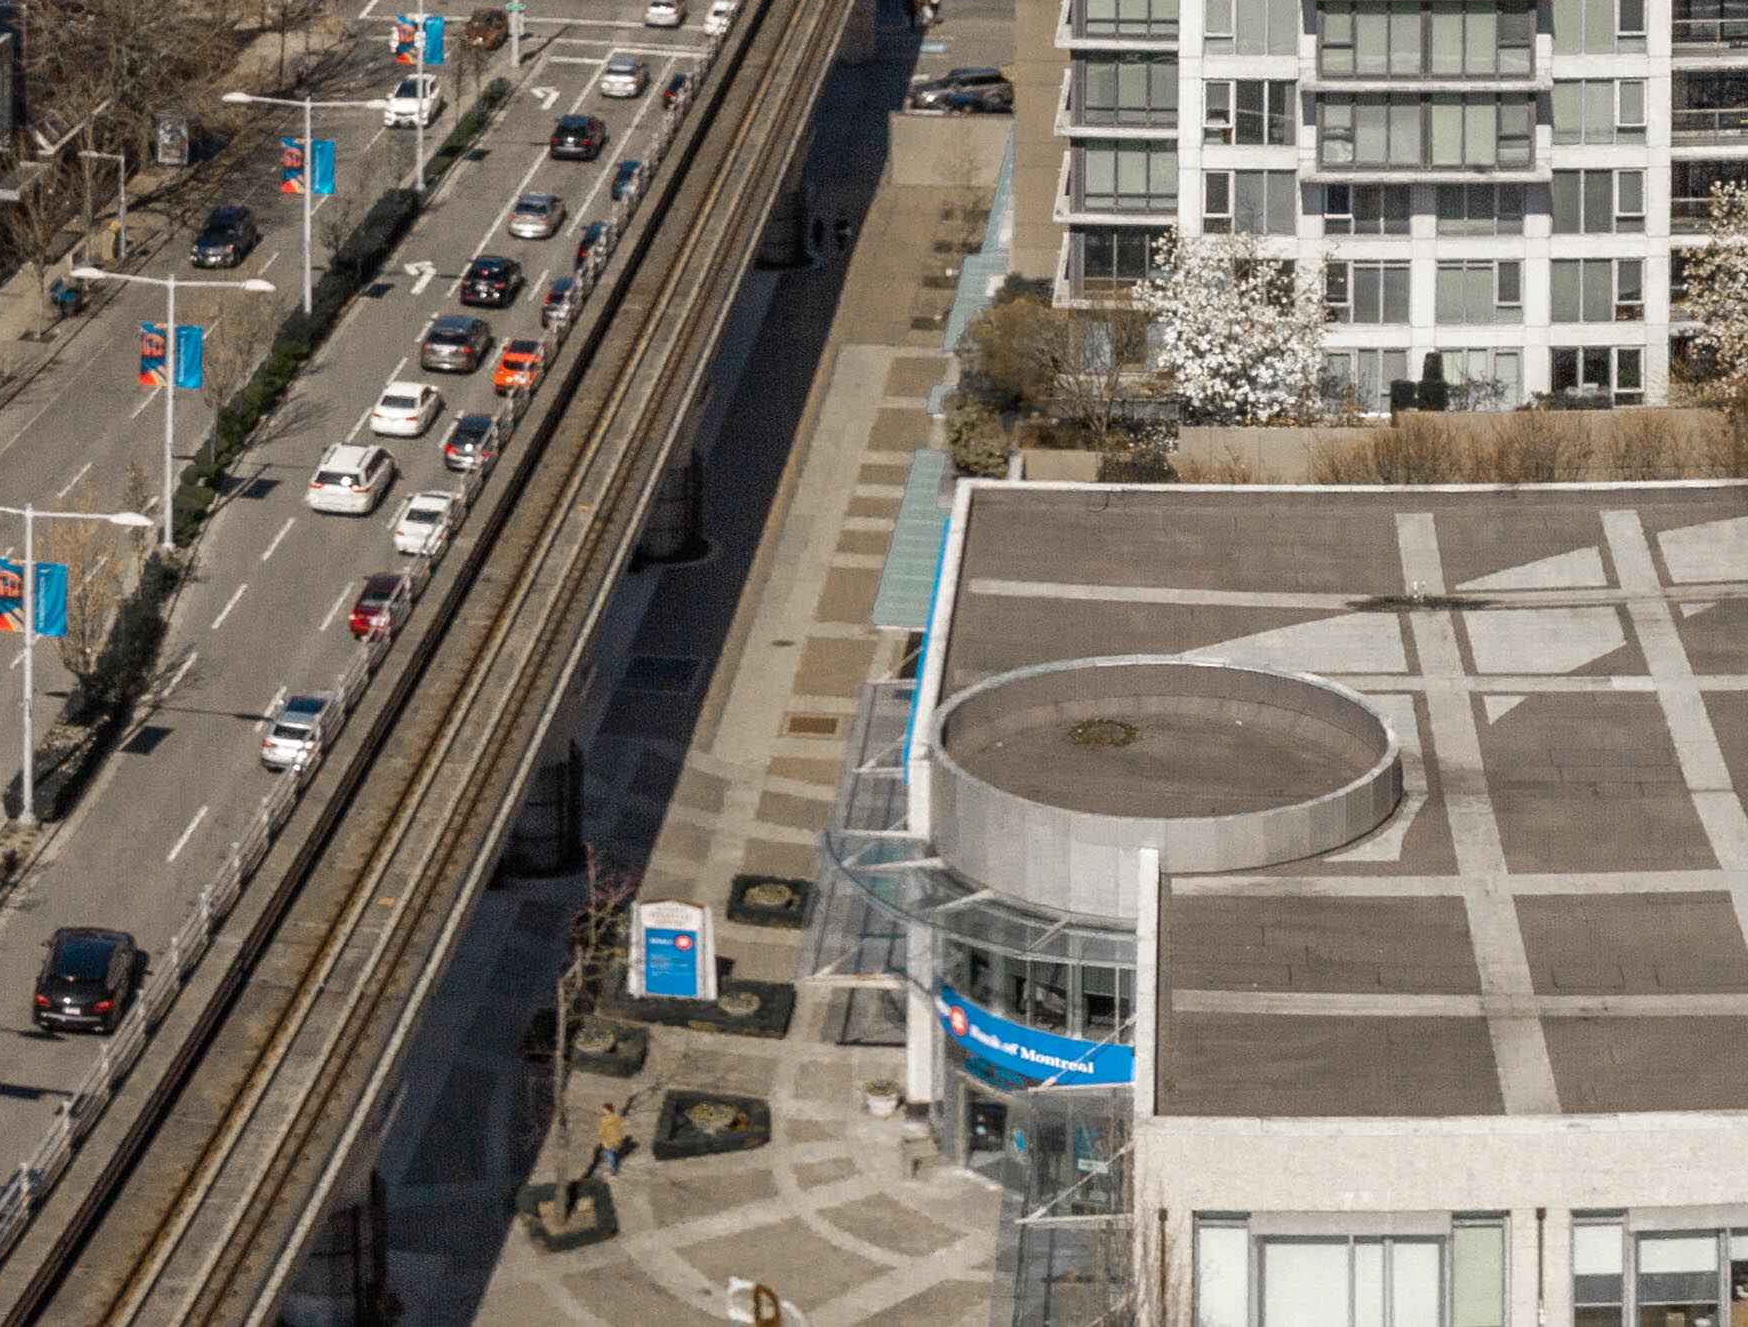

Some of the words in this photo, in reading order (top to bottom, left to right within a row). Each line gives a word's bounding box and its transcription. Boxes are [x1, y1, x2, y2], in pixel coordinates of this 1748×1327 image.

[969, 1023, 1001, 1049] Bank
[1001, 1042, 1019, 1057] of
[1020, 1046, 1094, 1074] Montreal
